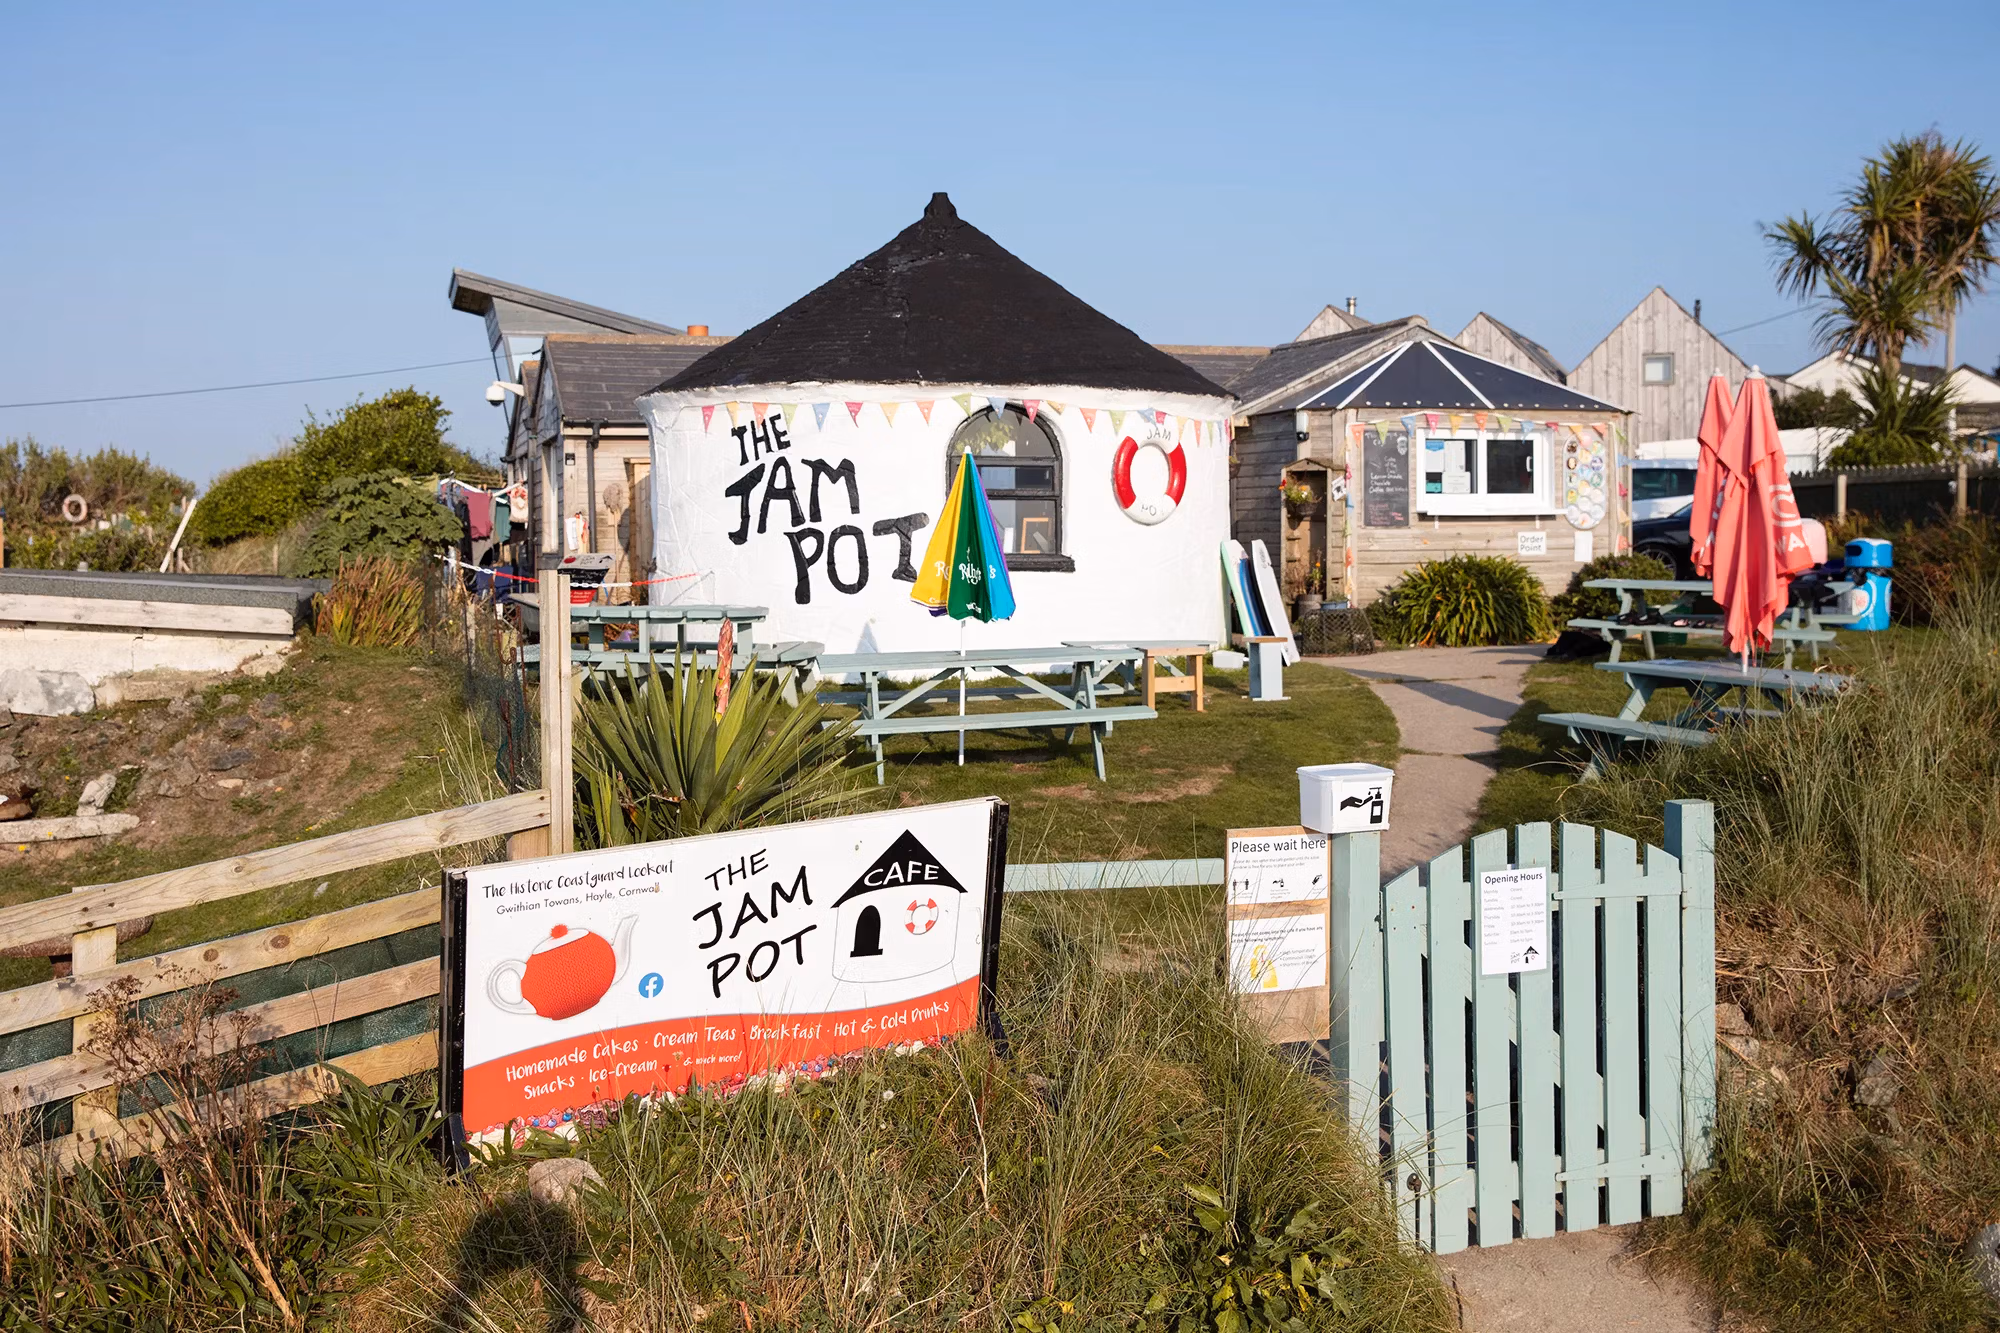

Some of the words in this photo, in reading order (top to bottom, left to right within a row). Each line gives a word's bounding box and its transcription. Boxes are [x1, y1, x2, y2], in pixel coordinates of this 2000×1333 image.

[731, 414, 791, 466] THE
[1147, 428, 1171, 441] JAM
[725, 456, 860, 545] JAM
[783, 512, 930, 605] POT
[1520, 535, 1544, 543] Order
[1520, 544, 1542, 552] Point
[1231, 841, 1270, 854] Please
[1273, 839, 1297, 851] wait
[1301, 838, 1327, 849] here
[482, 883, 506, 899] The
[510, 878, 553, 895] Historic
[558, 866, 625, 888] Coastguard
[628, 859, 674, 879] Lookout
[705, 848, 769, 891] THE
[863, 860, 939, 887] CAFE
[1484, 874, 1519, 885] Opening
[1520, 873, 1543, 881] Hours
[496, 901, 541, 915] Gwithian
[544, 896, 582, 909] Towans,
[585, 890, 616, 903] Hayle,
[692, 865, 813, 949] JAM
[707, 924, 817, 998] POT
[506, 1047, 587, 1082] Homemade
[593, 1039, 639, 1060] Cakes
[653, 1029, 698, 1048] Cream
[705, 1026, 736, 1042] Teas
[750, 1023, 822, 1041] Breakfast
[834, 1019, 857, 1037] Hot
[861, 1018, 876, 1033] &
[881, 1009, 907, 1030] Cold
[911, 1001, 950, 1023] Drinks
[683, 1057, 693, 1066] &
[696, 1054, 716, 1065] much
[719, 1050, 742, 1063] more!
[523, 1074, 575, 1100] Snacks
[589, 1059, 658, 1083] Ice-Cream
